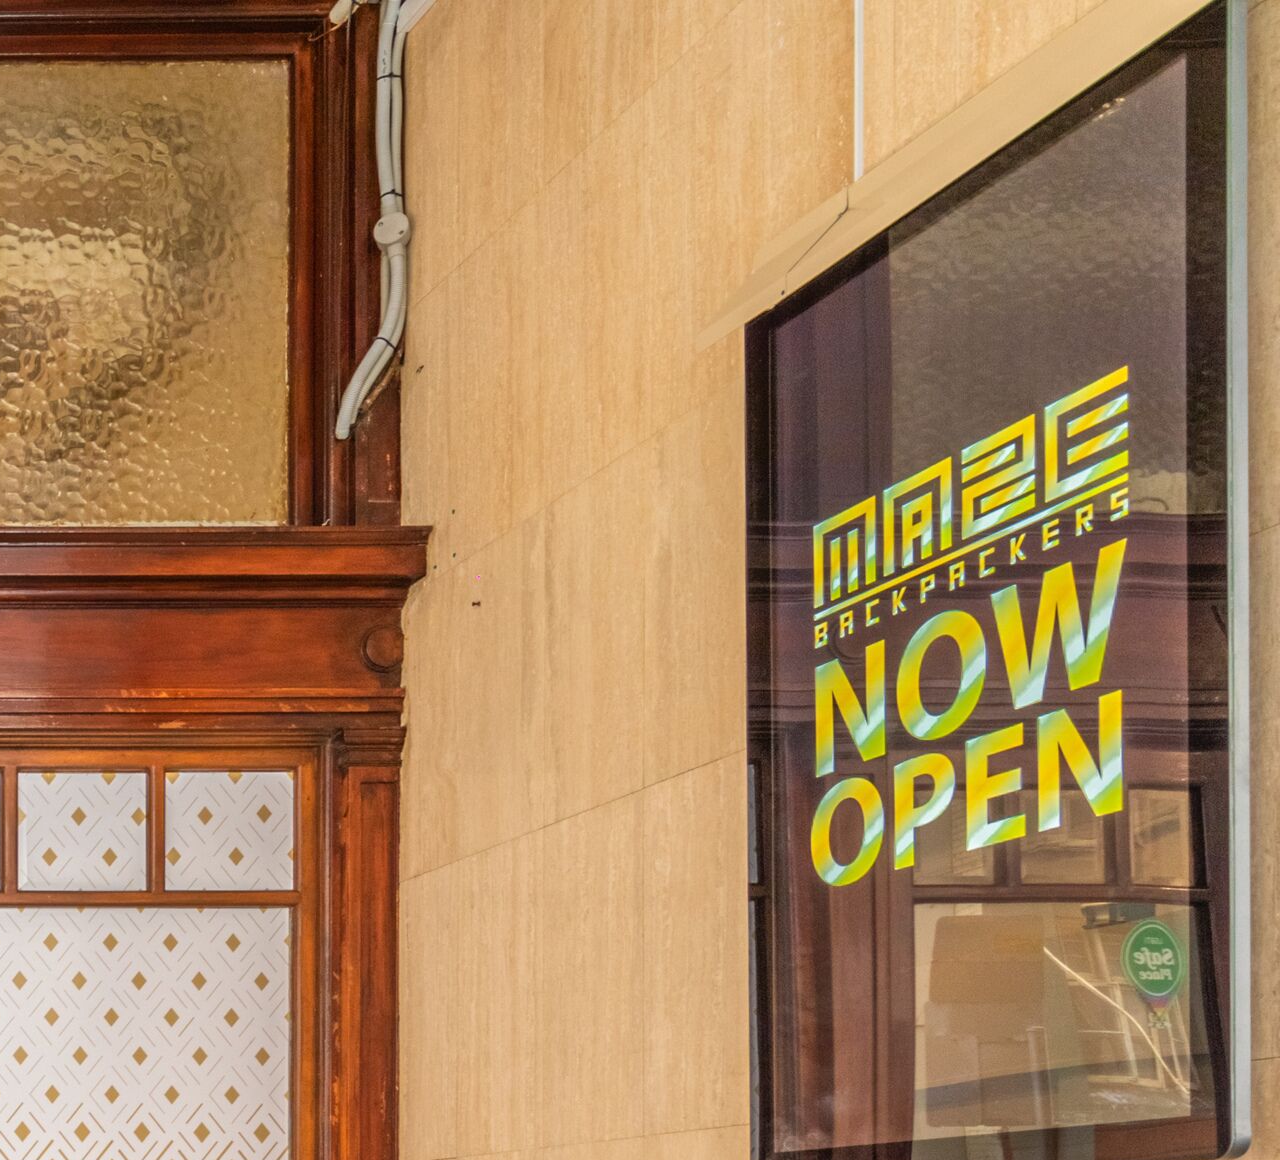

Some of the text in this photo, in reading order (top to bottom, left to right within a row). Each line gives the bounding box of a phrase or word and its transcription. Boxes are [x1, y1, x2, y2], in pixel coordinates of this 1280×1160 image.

[813, 365, 1129, 608] MAZE
[814, 487, 1129, 649] BACKPACKERS
[814, 538, 1127, 777] NOW
[810, 690, 1123, 887] OPEN
